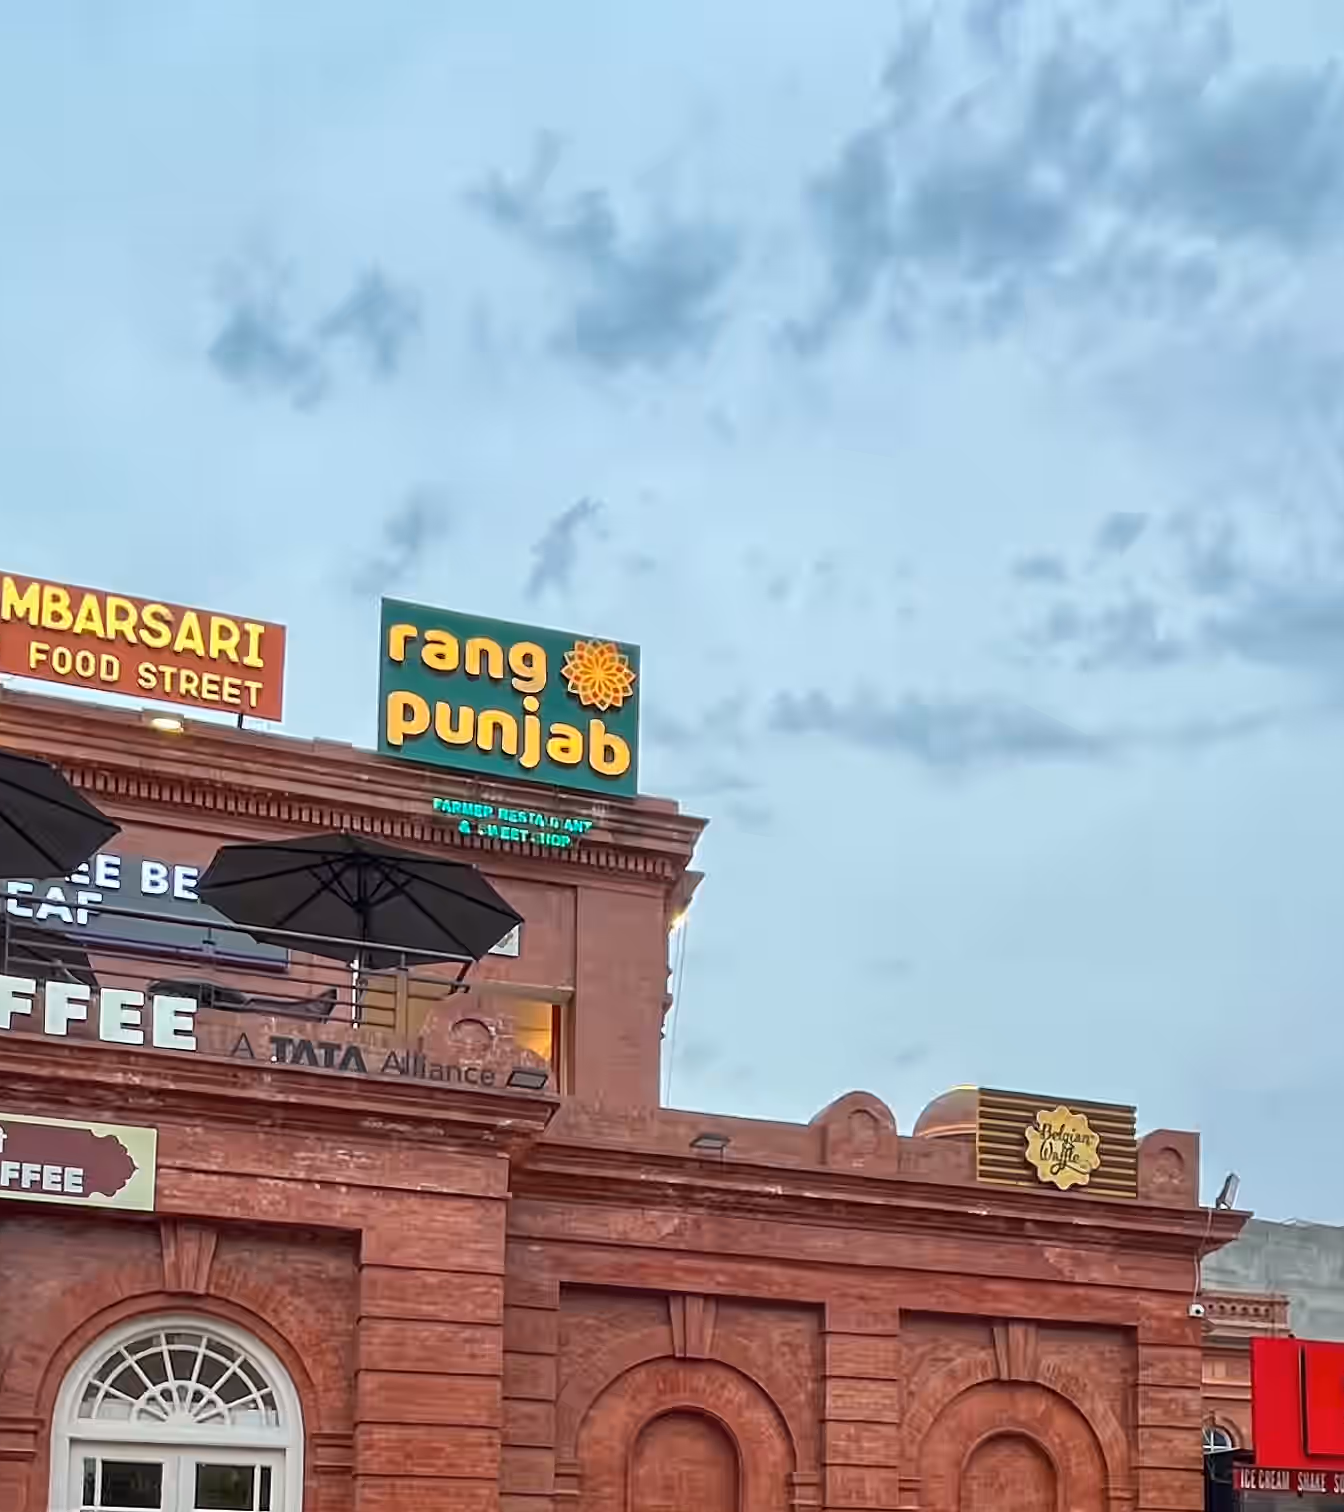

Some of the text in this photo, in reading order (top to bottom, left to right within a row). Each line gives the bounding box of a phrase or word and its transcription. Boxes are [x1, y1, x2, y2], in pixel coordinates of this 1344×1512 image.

[29, 641, 264, 708] FOOD STREET
[388, 623, 548, 694] rang
[386, 690, 631, 776] punjab
[140, 859, 201, 902] BE
[231, 1031, 496, 1087] A TATA Alliance
[1039, 1122, 1094, 1146] Belgian
[1240, 1469, 1256, 1489] ICE
[1258, 1470, 1290, 1490] CREAM
[1297, 1471, 1327, 1493] SHAKE
